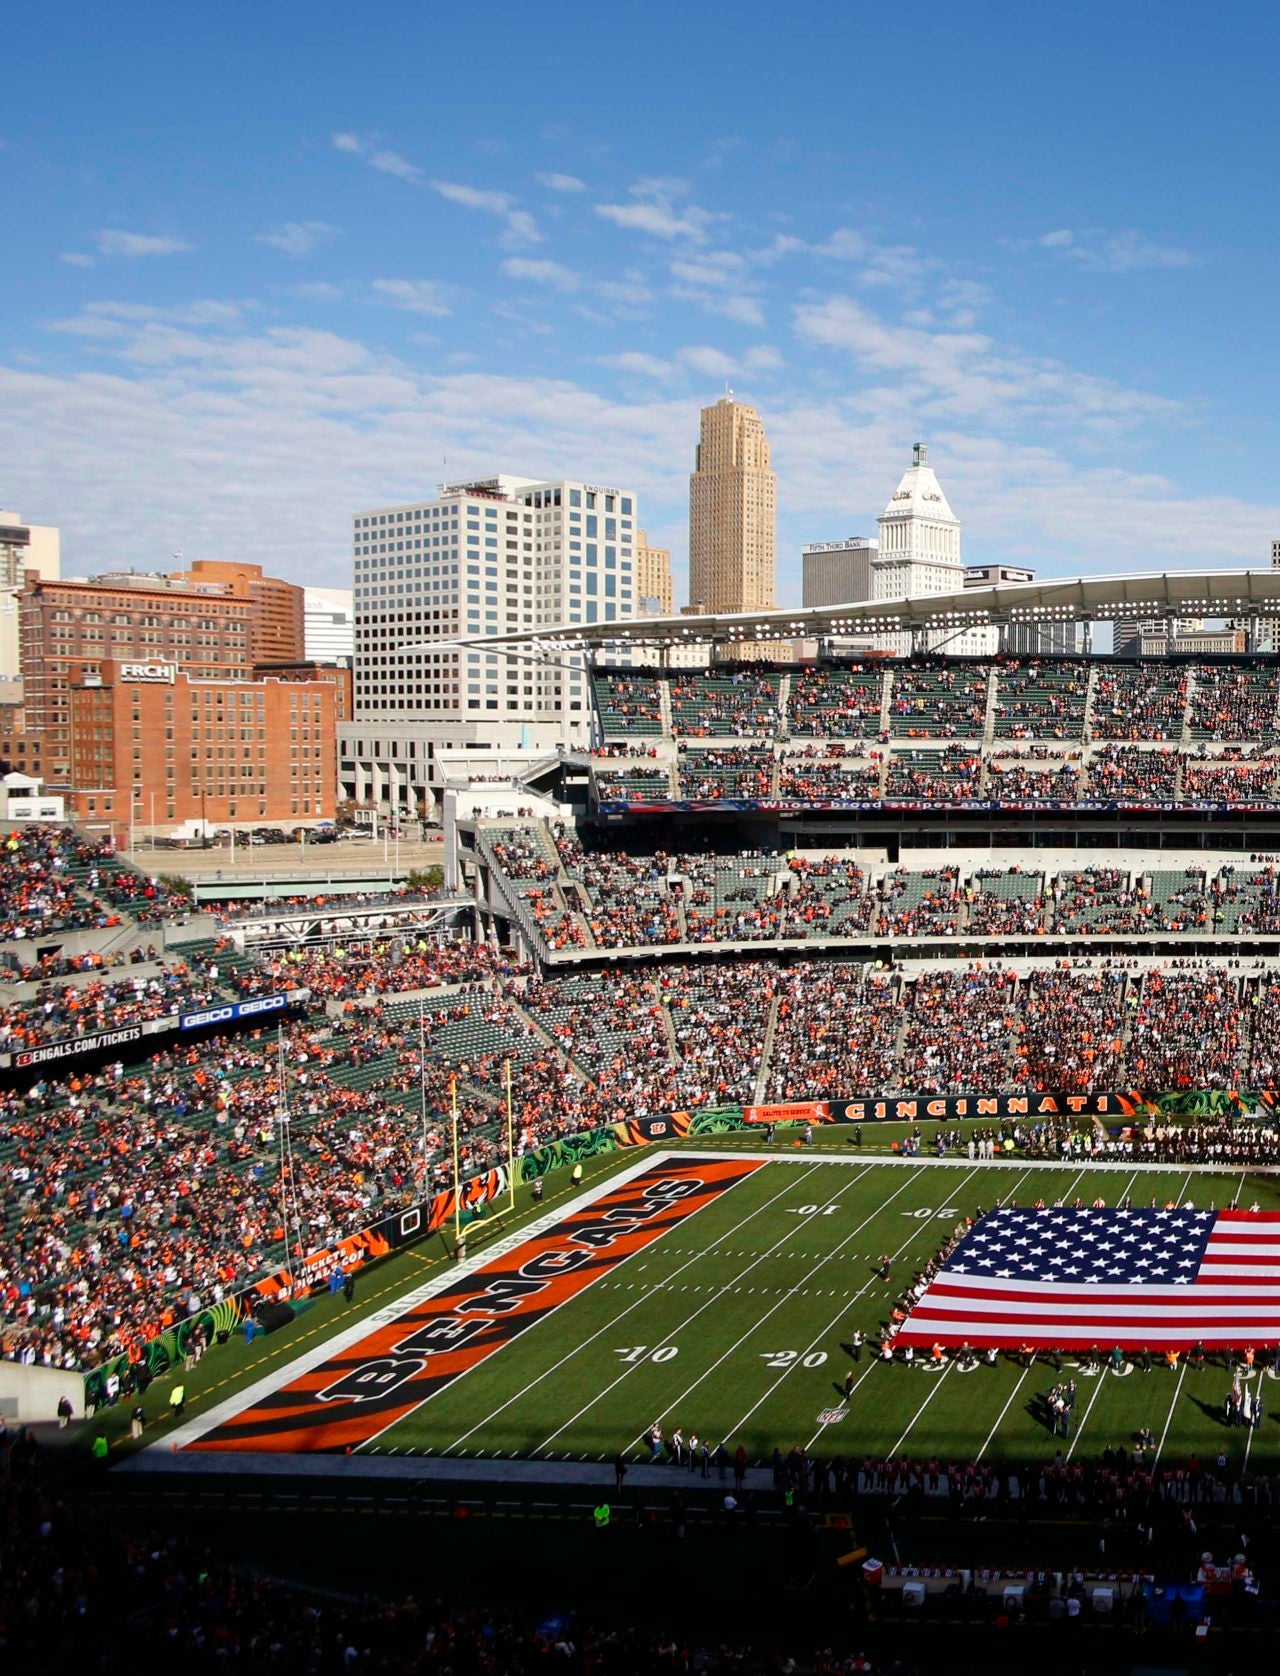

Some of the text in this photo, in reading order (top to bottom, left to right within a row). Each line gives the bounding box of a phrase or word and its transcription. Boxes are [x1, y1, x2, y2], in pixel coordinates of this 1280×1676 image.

[121, 664, 170, 678] FRCH
[762, 801, 823, 809] Whose
[830, 801, 882, 809] broad
[890, 801, 952, 810] stripes
[960, 801, 991, 809] and
[1000, 801, 1051, 810] bright
[1116, 801, 1184, 811] through
[1192, 801, 1218, 810] the
[184, 996, 284, 1027] GEICO GEICO
[16, 1028, 140, 1067] BENGALS.COM/TICKETS
[845, 1095, 1108, 1119] CINCINNATI
[797, 1204, 842, 1216] 10
[913, 1207, 959, 1219] 20
[372, 1216, 561, 1322] SALUTE TO SERVICE
[315, 1179, 704, 1402] BENGALS
[619, 1345, 678, 1363] 10
[767, 1350, 828, 1368] 20
